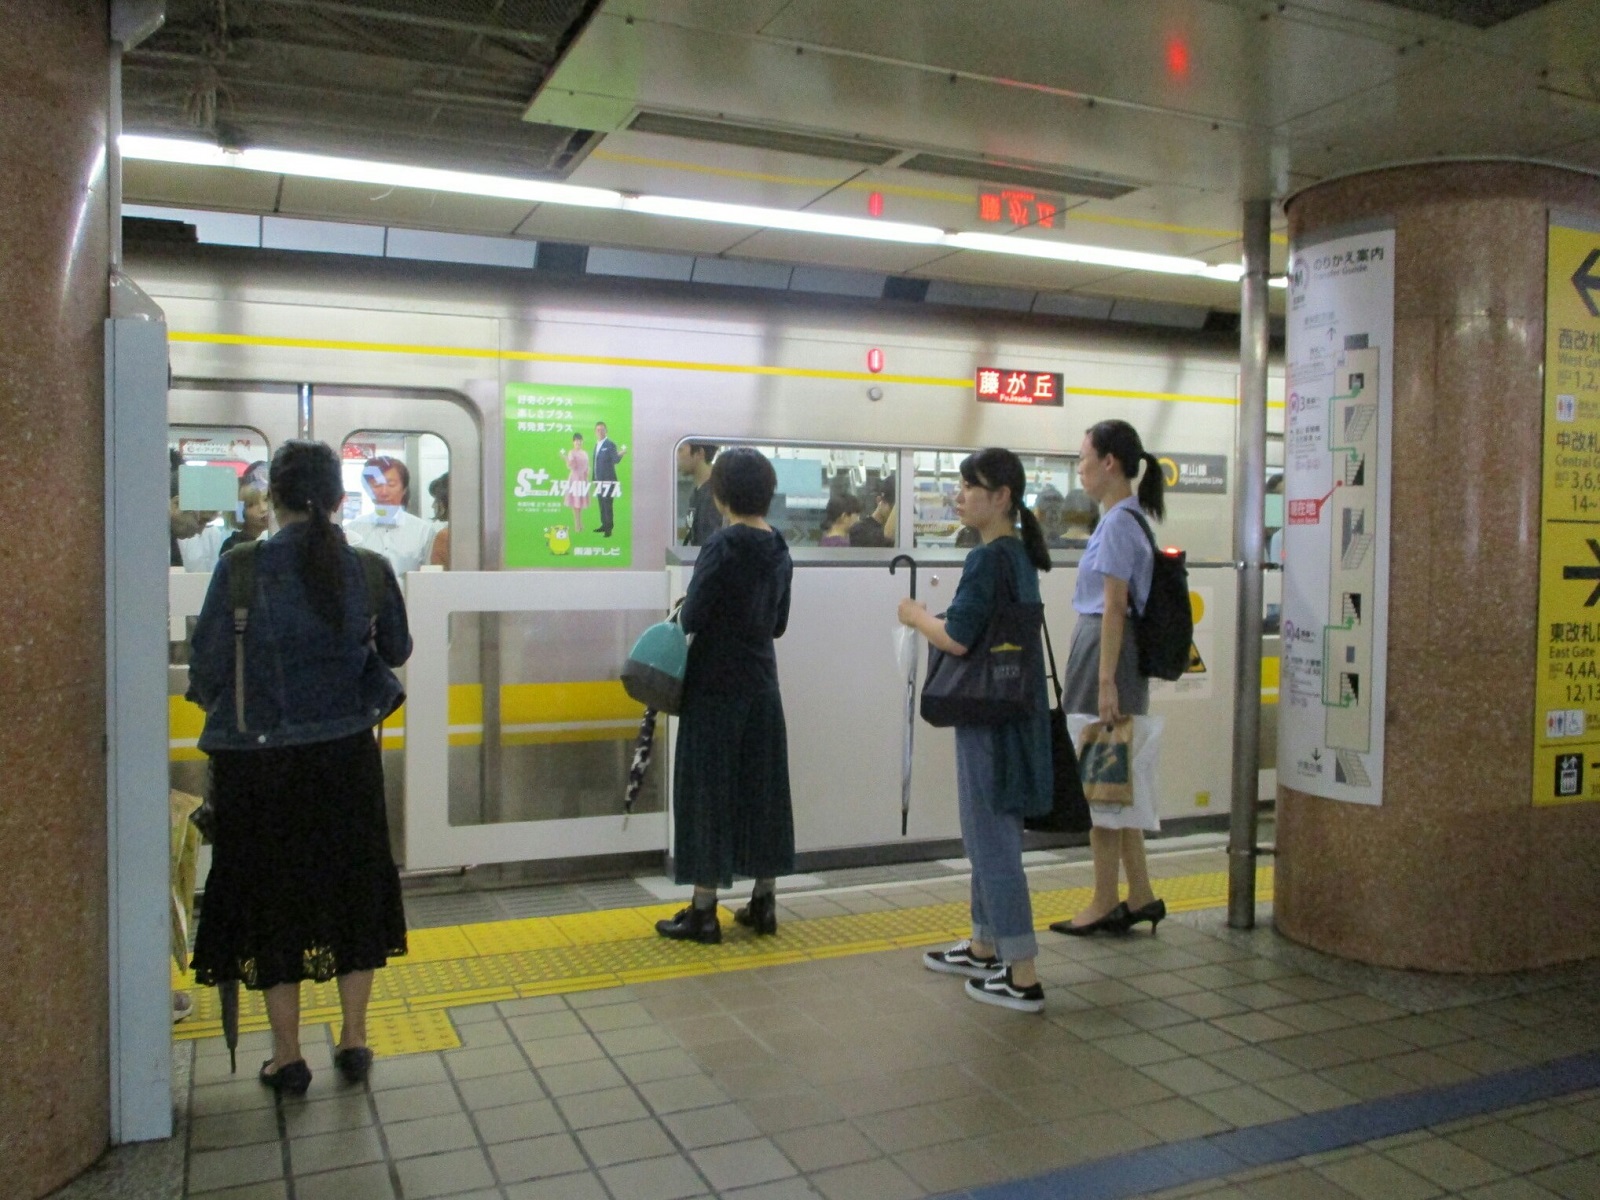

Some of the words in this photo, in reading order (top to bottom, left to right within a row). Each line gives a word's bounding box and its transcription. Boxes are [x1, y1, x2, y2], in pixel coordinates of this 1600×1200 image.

[979, 370, 1053, 397] 藤が丘
[1550, 623, 1600, 642] 東改札
[1550, 646, 1570, 658] East
[1573, 646, 1595, 658] Gate
